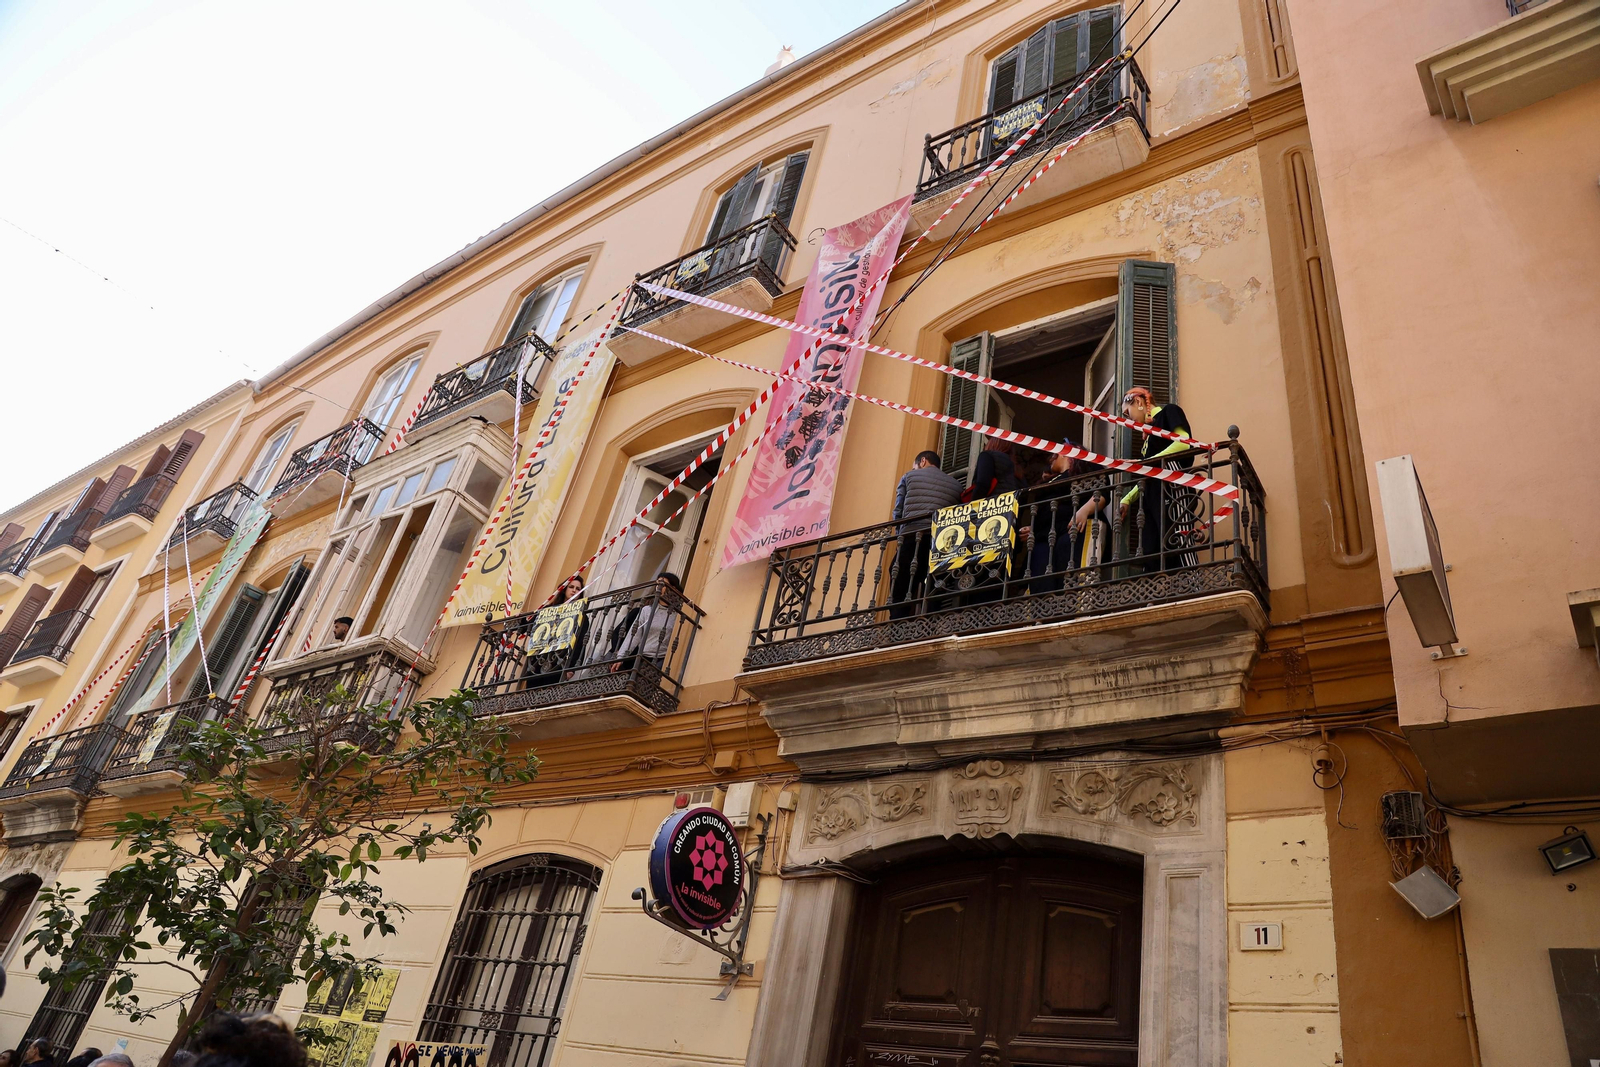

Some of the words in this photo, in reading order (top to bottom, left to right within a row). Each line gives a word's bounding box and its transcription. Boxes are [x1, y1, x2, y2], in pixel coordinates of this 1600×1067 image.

[480, 457, 547, 576] Cultura
[536, 375, 577, 450] Libre
[772, 459, 816, 511] la
[936, 515, 971, 528] CENSURA
[977, 505, 1014, 519] CENSURA
[938, 504, 973, 520] PACO
[979, 494, 1014, 511] PACO
[453, 600, 524, 618] lainvisiblene
[539, 606, 559, 619] PACO
[562, 600, 583, 613] PACO
[673, 817, 701, 854] CREANDO
[701, 815, 727, 833] CIUDAD
[725, 831, 734, 845] EN
[731, 846, 741, 885] COMÚN
[681, 882, 689, 895] la
[690, 886, 721, 910] invisible
[1254, 926, 1268, 945] 11
[418, 1044, 433, 1057] SE
[436, 1044, 464, 1057] VENDE
